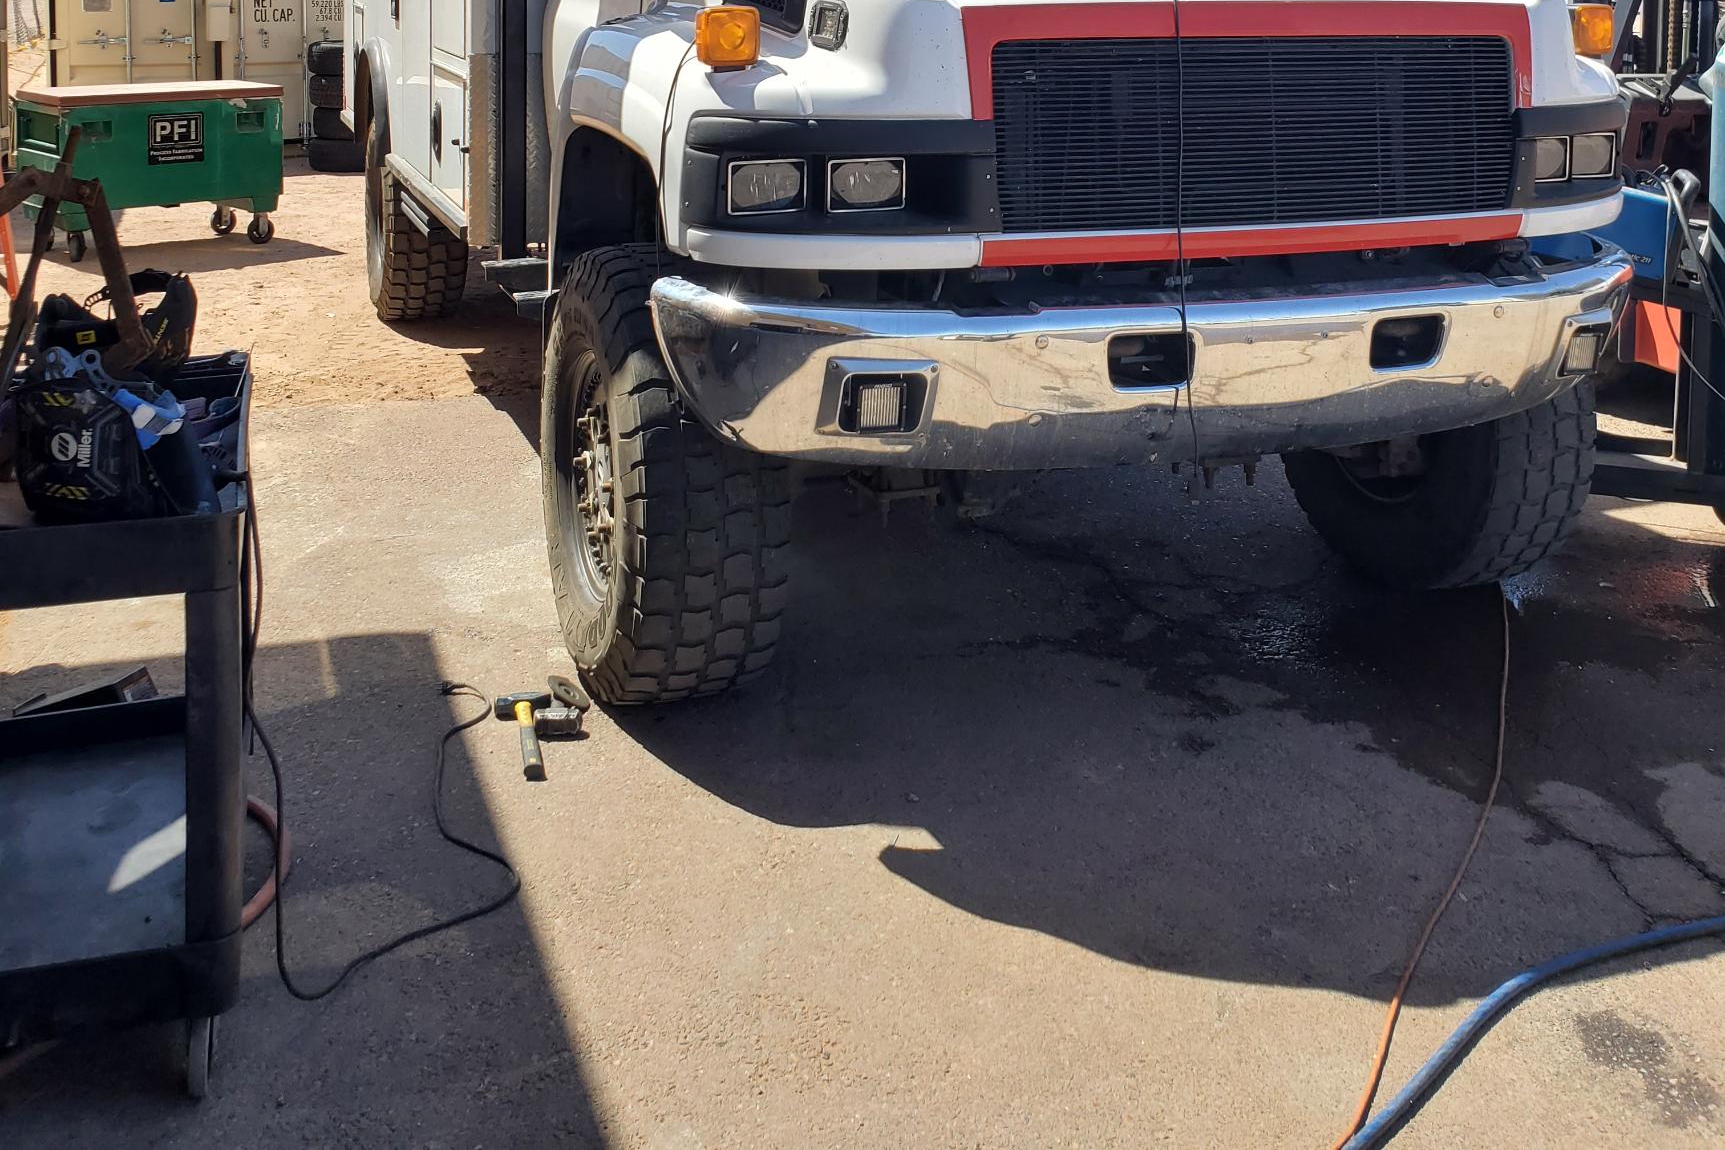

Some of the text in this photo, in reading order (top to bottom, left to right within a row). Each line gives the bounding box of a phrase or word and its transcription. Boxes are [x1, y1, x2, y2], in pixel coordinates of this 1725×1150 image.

[254, 9, 296, 22] CU. CAP.
[155, 120, 196, 142] PFI
